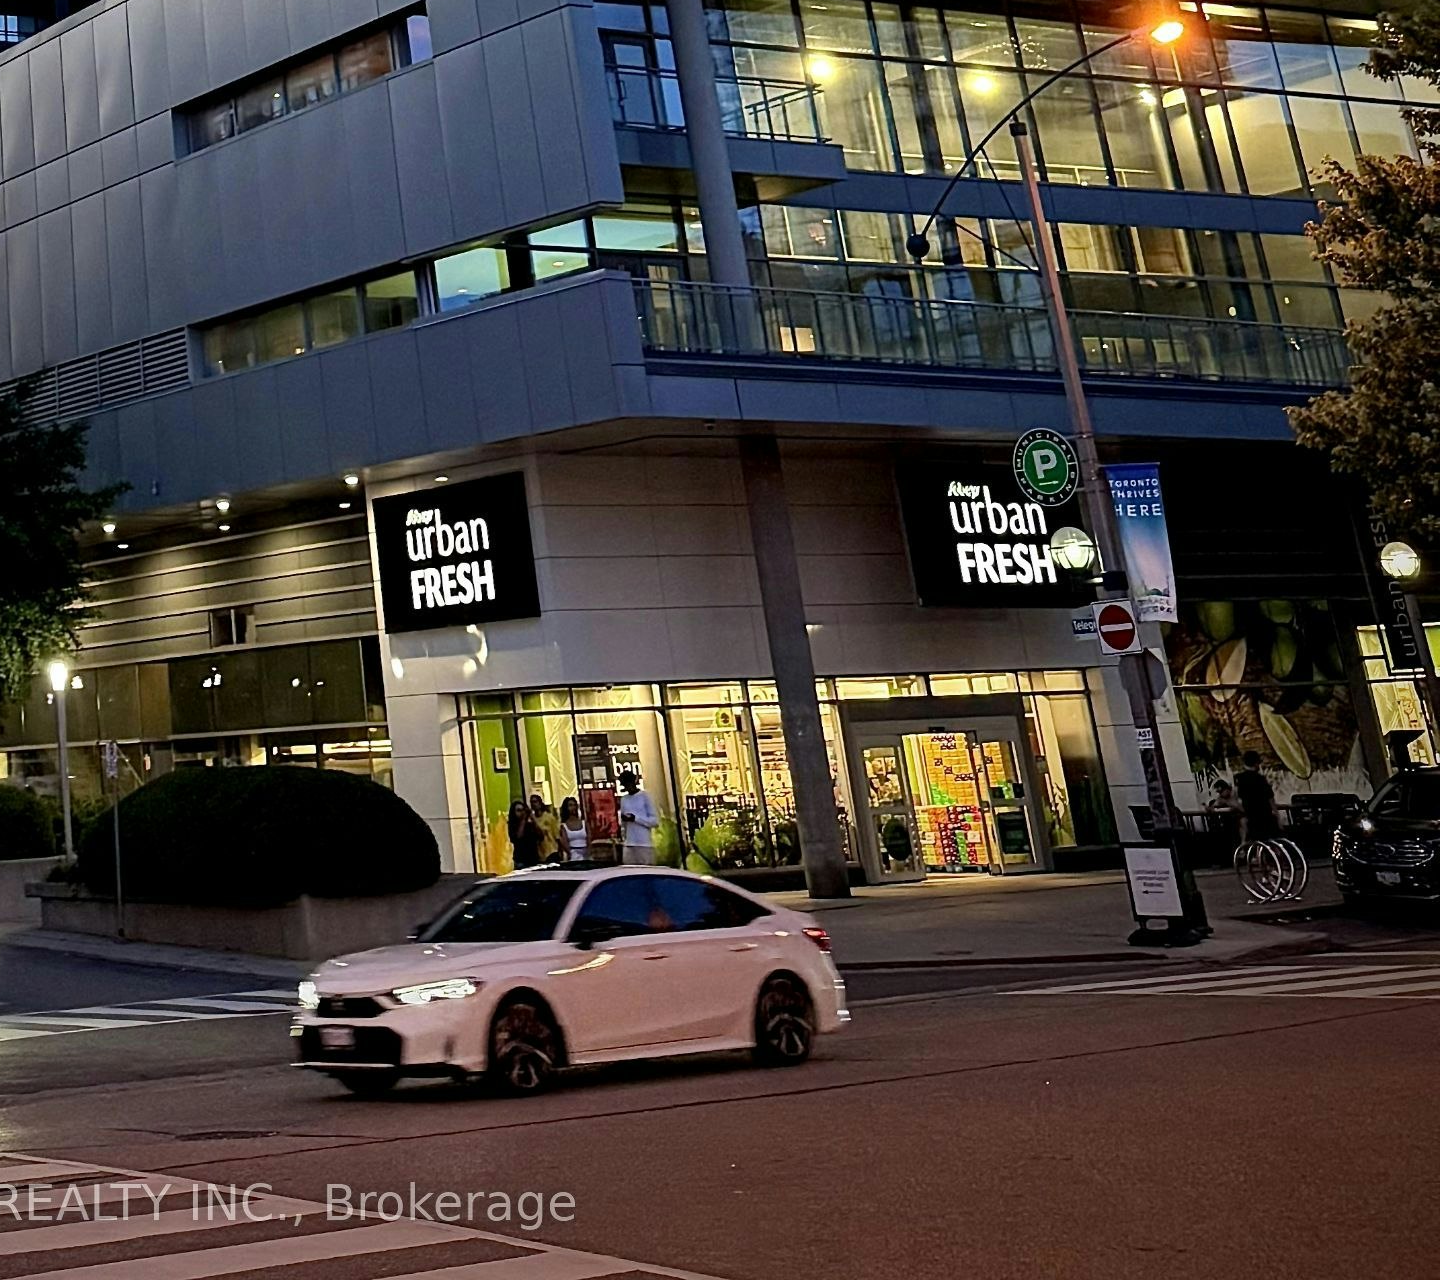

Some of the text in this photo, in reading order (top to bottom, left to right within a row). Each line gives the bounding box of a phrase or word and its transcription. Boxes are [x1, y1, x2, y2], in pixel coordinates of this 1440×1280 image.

[1017, 432, 1072, 468] MUNICIPAL
[1032, 448, 1058, 479] P
[1020, 471, 1076, 503] PARKING
[1108, 478, 1159, 487] TORONTO
[1111, 489, 1160, 499] THRIVES
[949, 485, 1048, 535] urban
[1115, 503, 1162, 517] HERE
[406, 508, 490, 562] urban
[956, 542, 1058, 585] FRESH
[410, 559, 496, 610] FRESH
[1388, 580, 1417, 657] urban
